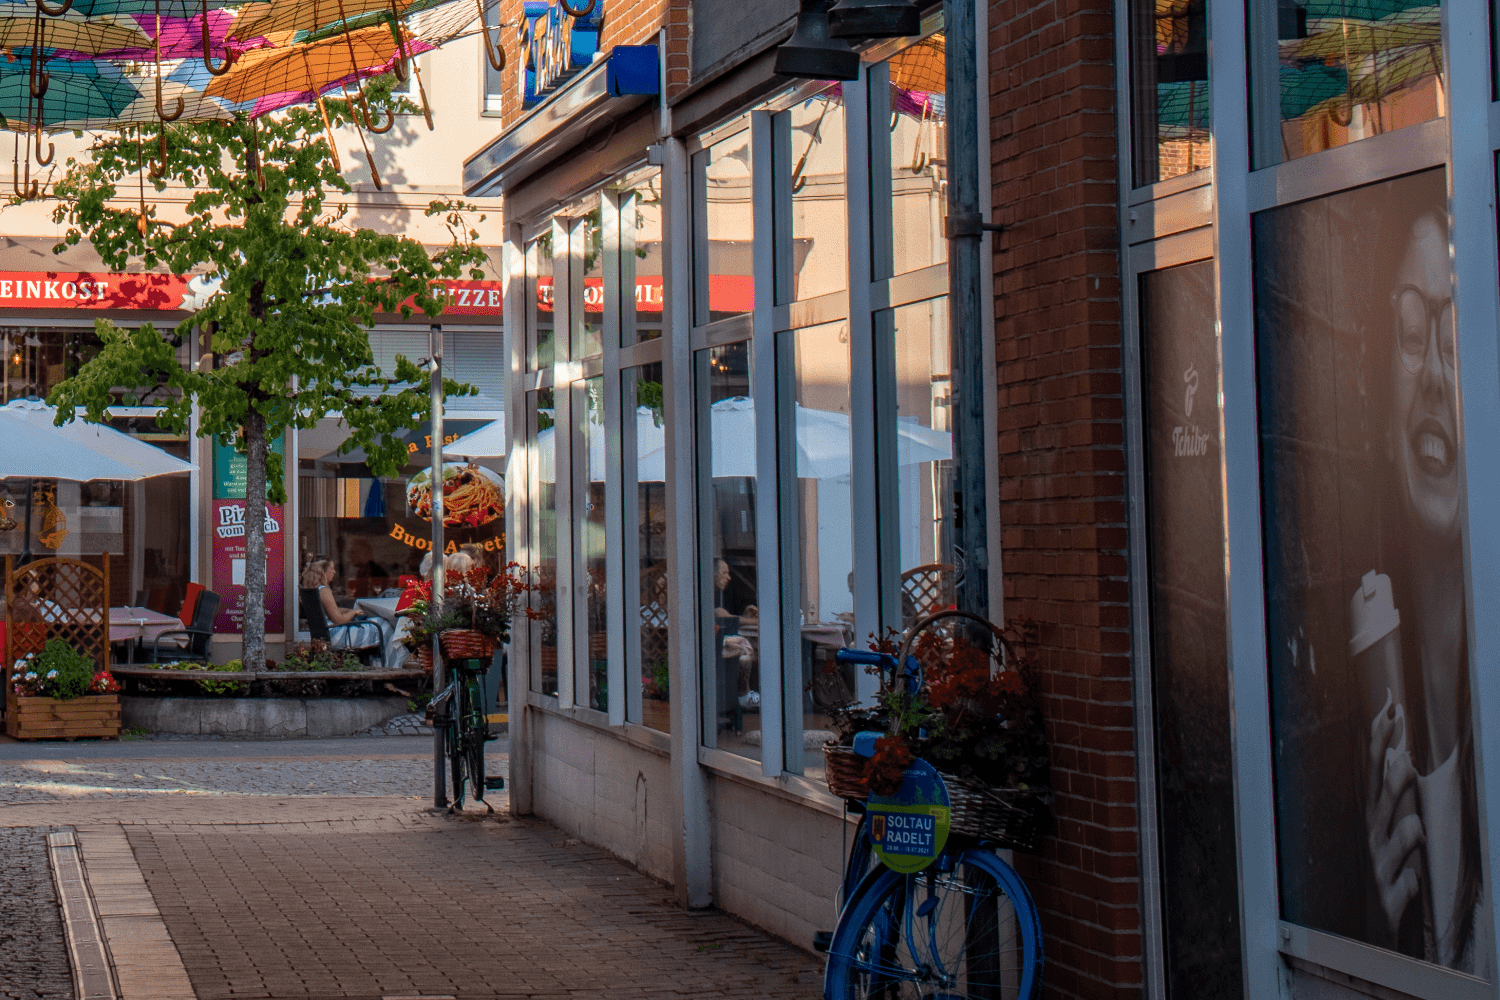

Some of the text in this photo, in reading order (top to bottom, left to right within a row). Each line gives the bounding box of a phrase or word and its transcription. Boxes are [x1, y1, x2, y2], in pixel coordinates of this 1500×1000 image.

[1173, 425, 1210, 457] Tchibo
[219, 527, 243, 536] vom
[887, 815, 932, 831] SOLTAU
[886, 830, 932, 846] RADELT
